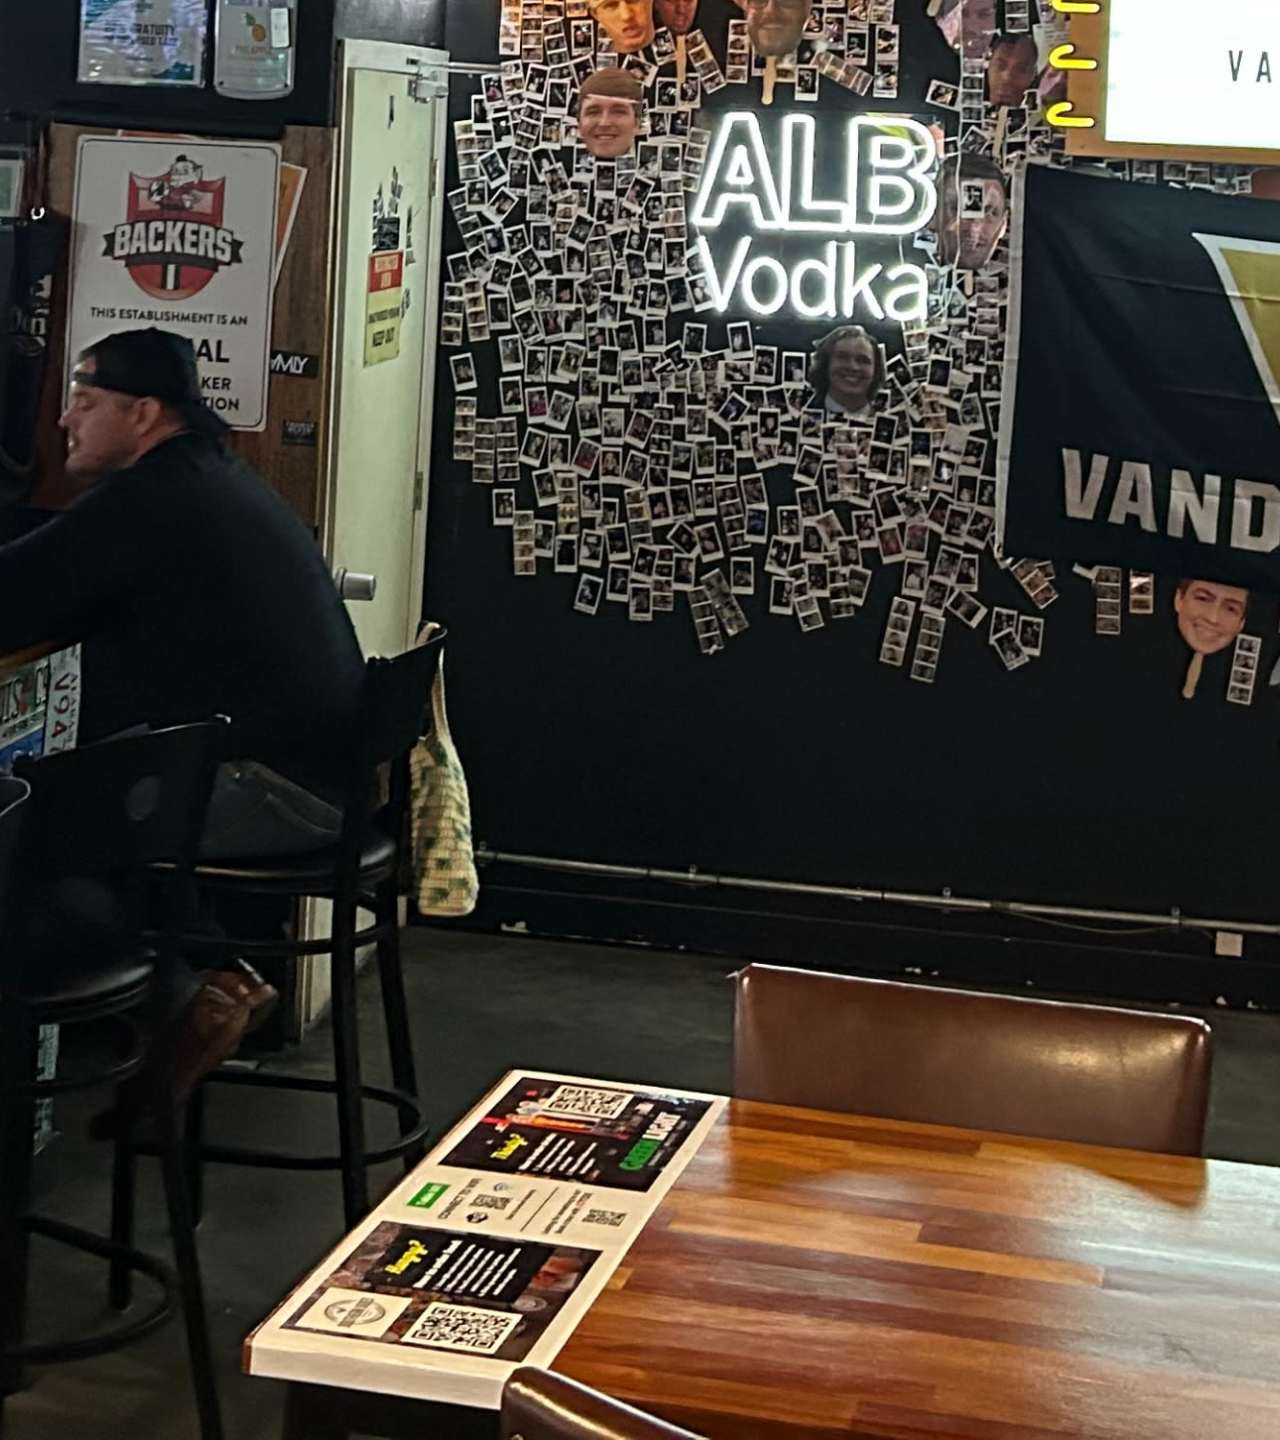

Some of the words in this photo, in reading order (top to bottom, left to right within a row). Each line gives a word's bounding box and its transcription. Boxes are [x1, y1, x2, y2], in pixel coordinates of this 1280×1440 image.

[692, 111, 938, 234] ALB
[114, 221, 234, 263] BACKERS
[696, 235, 929, 321] Vodka
[90, 306, 116, 319] THIS
[119, 308, 214, 326] ESTABLISHMENT
[216, 313, 226, 326] IS
[229, 314, 248, 326] AN
[642, 1111, 682, 1140] LIGHT
